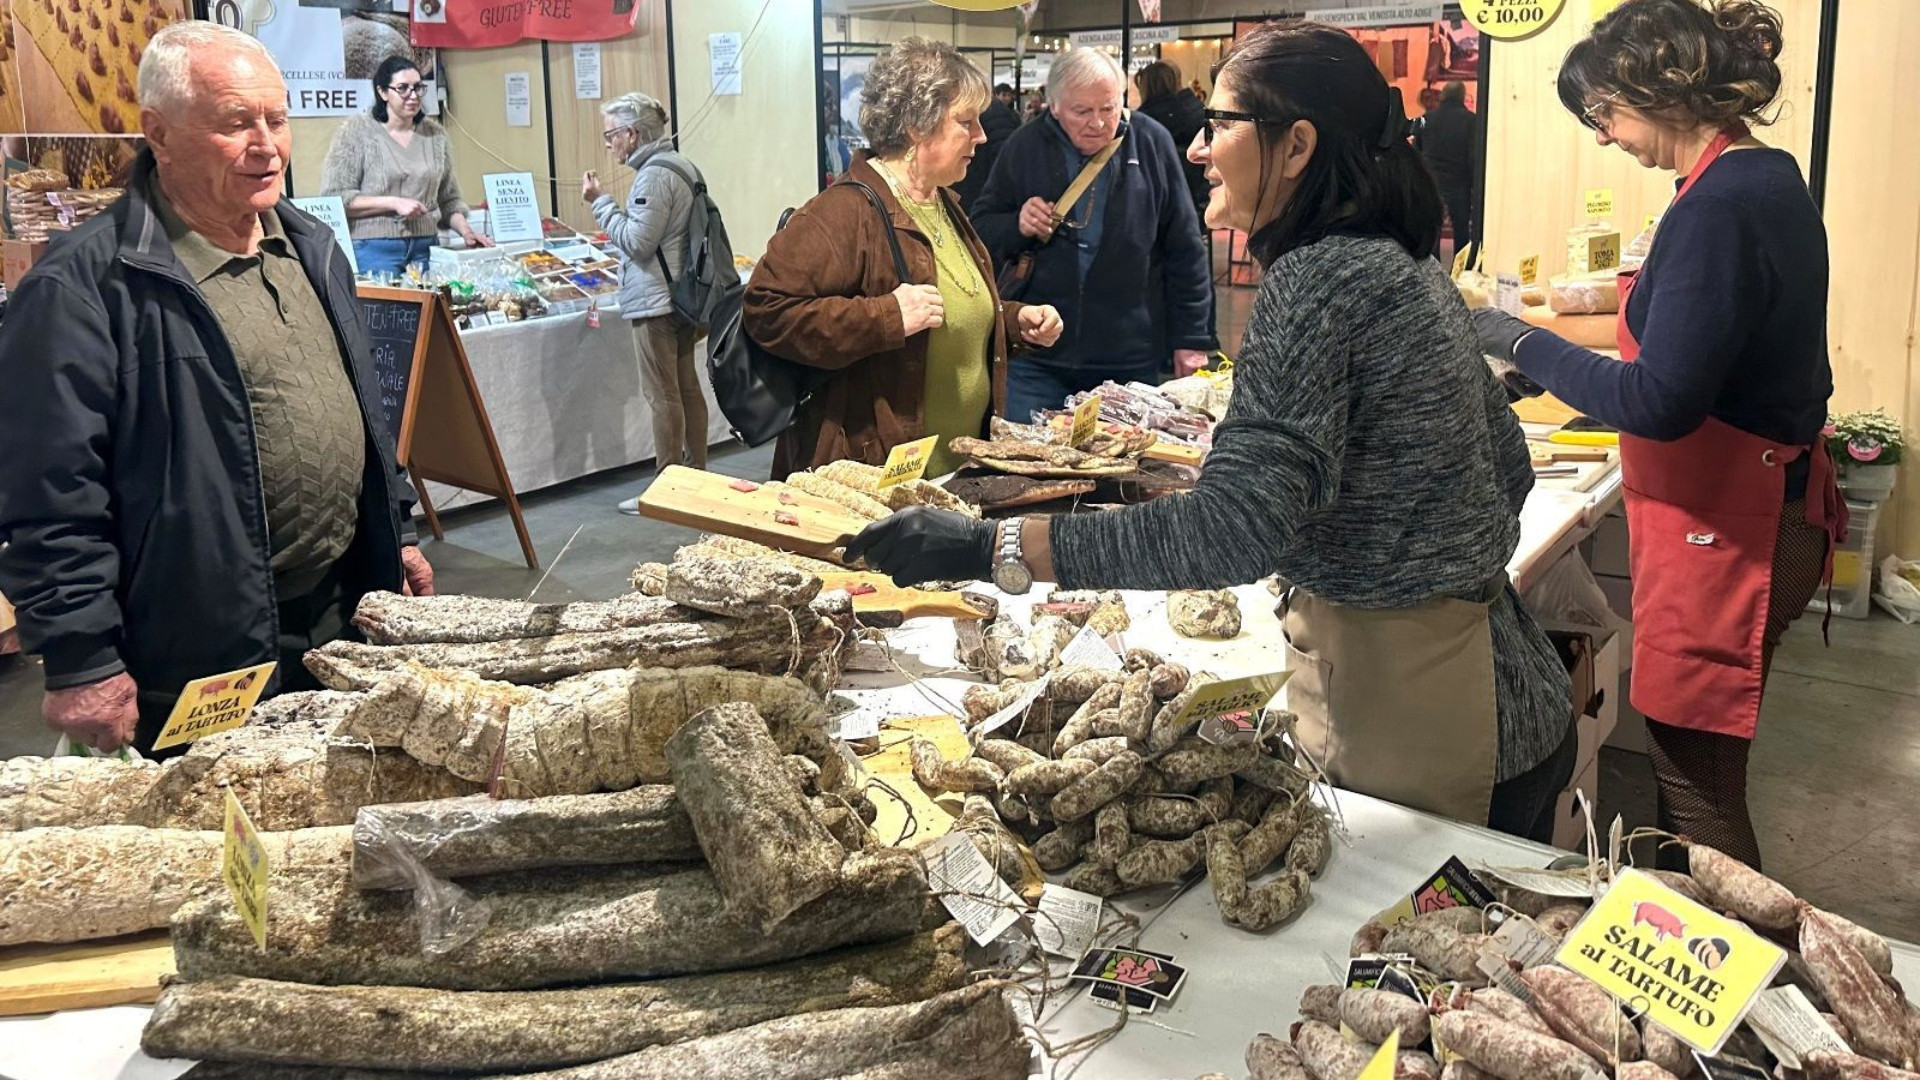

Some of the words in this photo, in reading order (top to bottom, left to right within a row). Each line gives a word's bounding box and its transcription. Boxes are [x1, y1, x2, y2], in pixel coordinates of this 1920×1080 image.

[527, 0, 572, 19] FREE
[1476, 10, 1489, 24] €
[1495, 7, 1544, 24] 10,00
[300, 90, 358, 109] FREE
[497, 178, 521, 187] LINEA
[498, 187, 525, 196] SENZA
[186, 695, 241, 720] LONZA
[166, 724, 183, 738] al
[184, 707, 247, 733] TARTUFO
[1603, 924, 1726, 1004] SALAME
[1579, 941, 1606, 965] al
[1607, 952, 1716, 1030] TARTUFO
